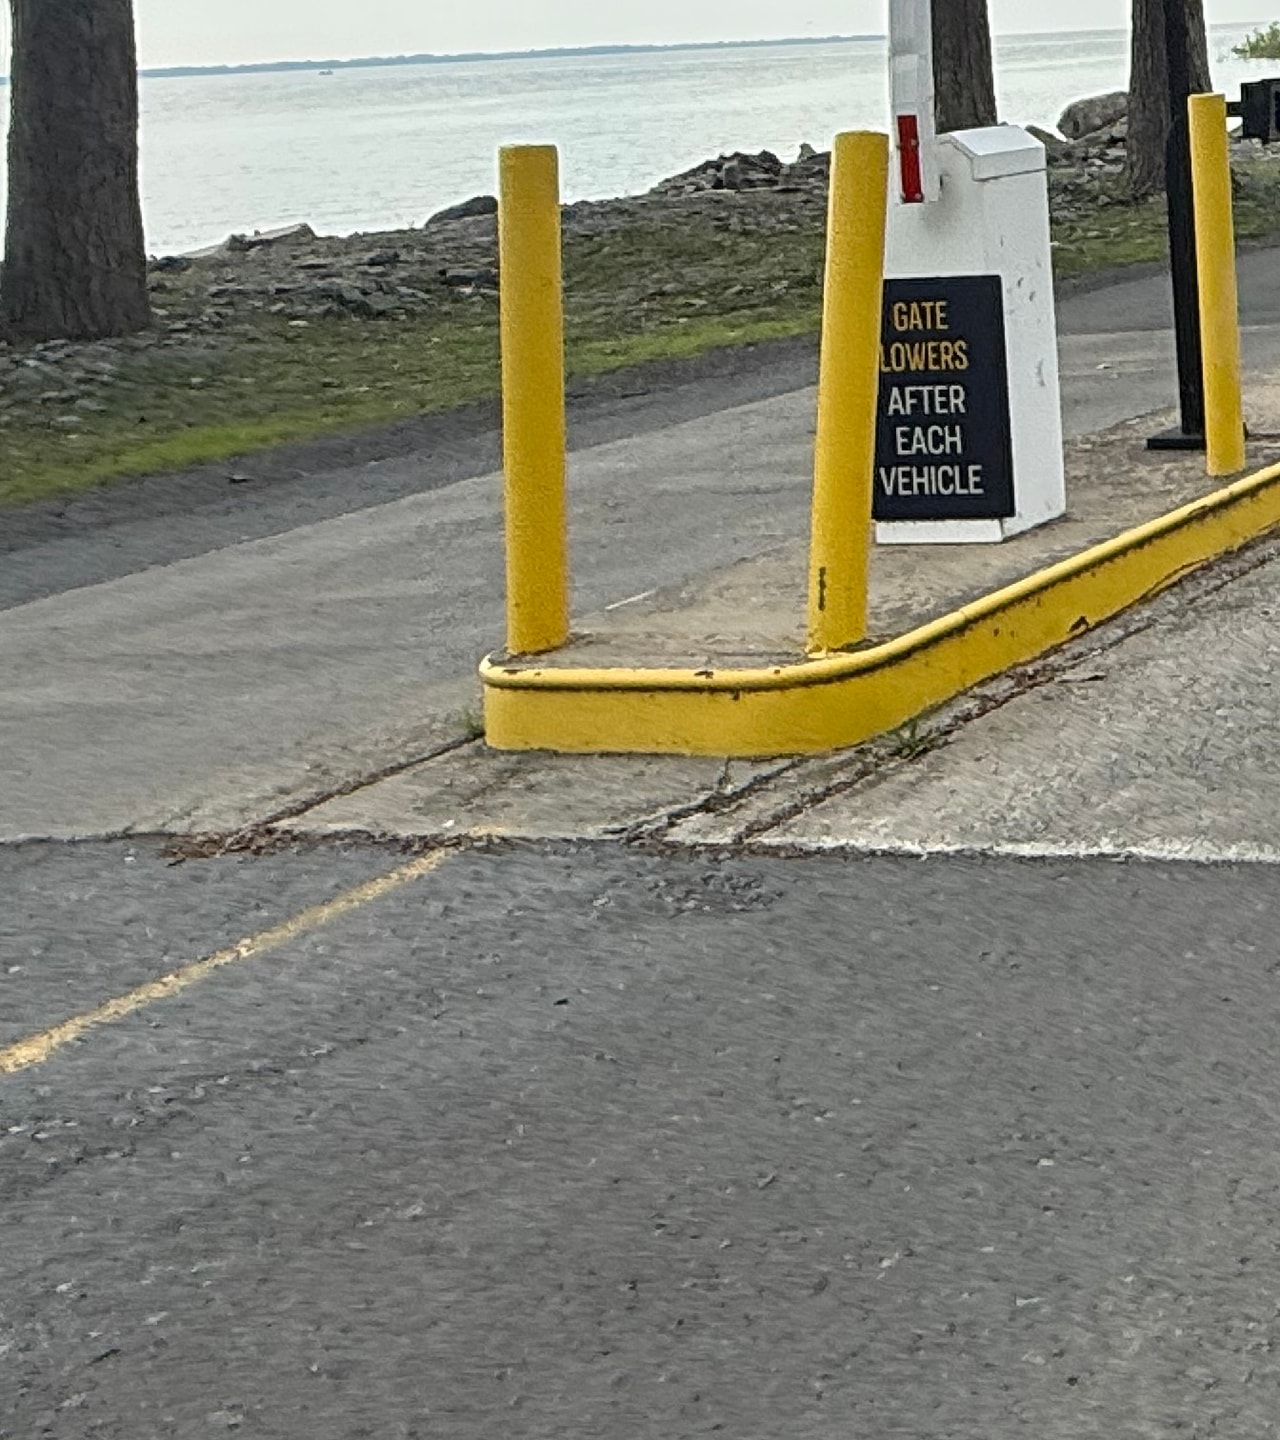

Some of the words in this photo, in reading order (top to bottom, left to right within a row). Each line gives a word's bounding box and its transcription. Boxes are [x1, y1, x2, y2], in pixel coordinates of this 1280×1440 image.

[893, 301, 949, 332] GATE
[880, 340, 969, 372] LOWERS
[887, 385, 966, 415] AFTER
[896, 425, 962, 455] EACH
[879, 464, 984, 495] VEHICLE
